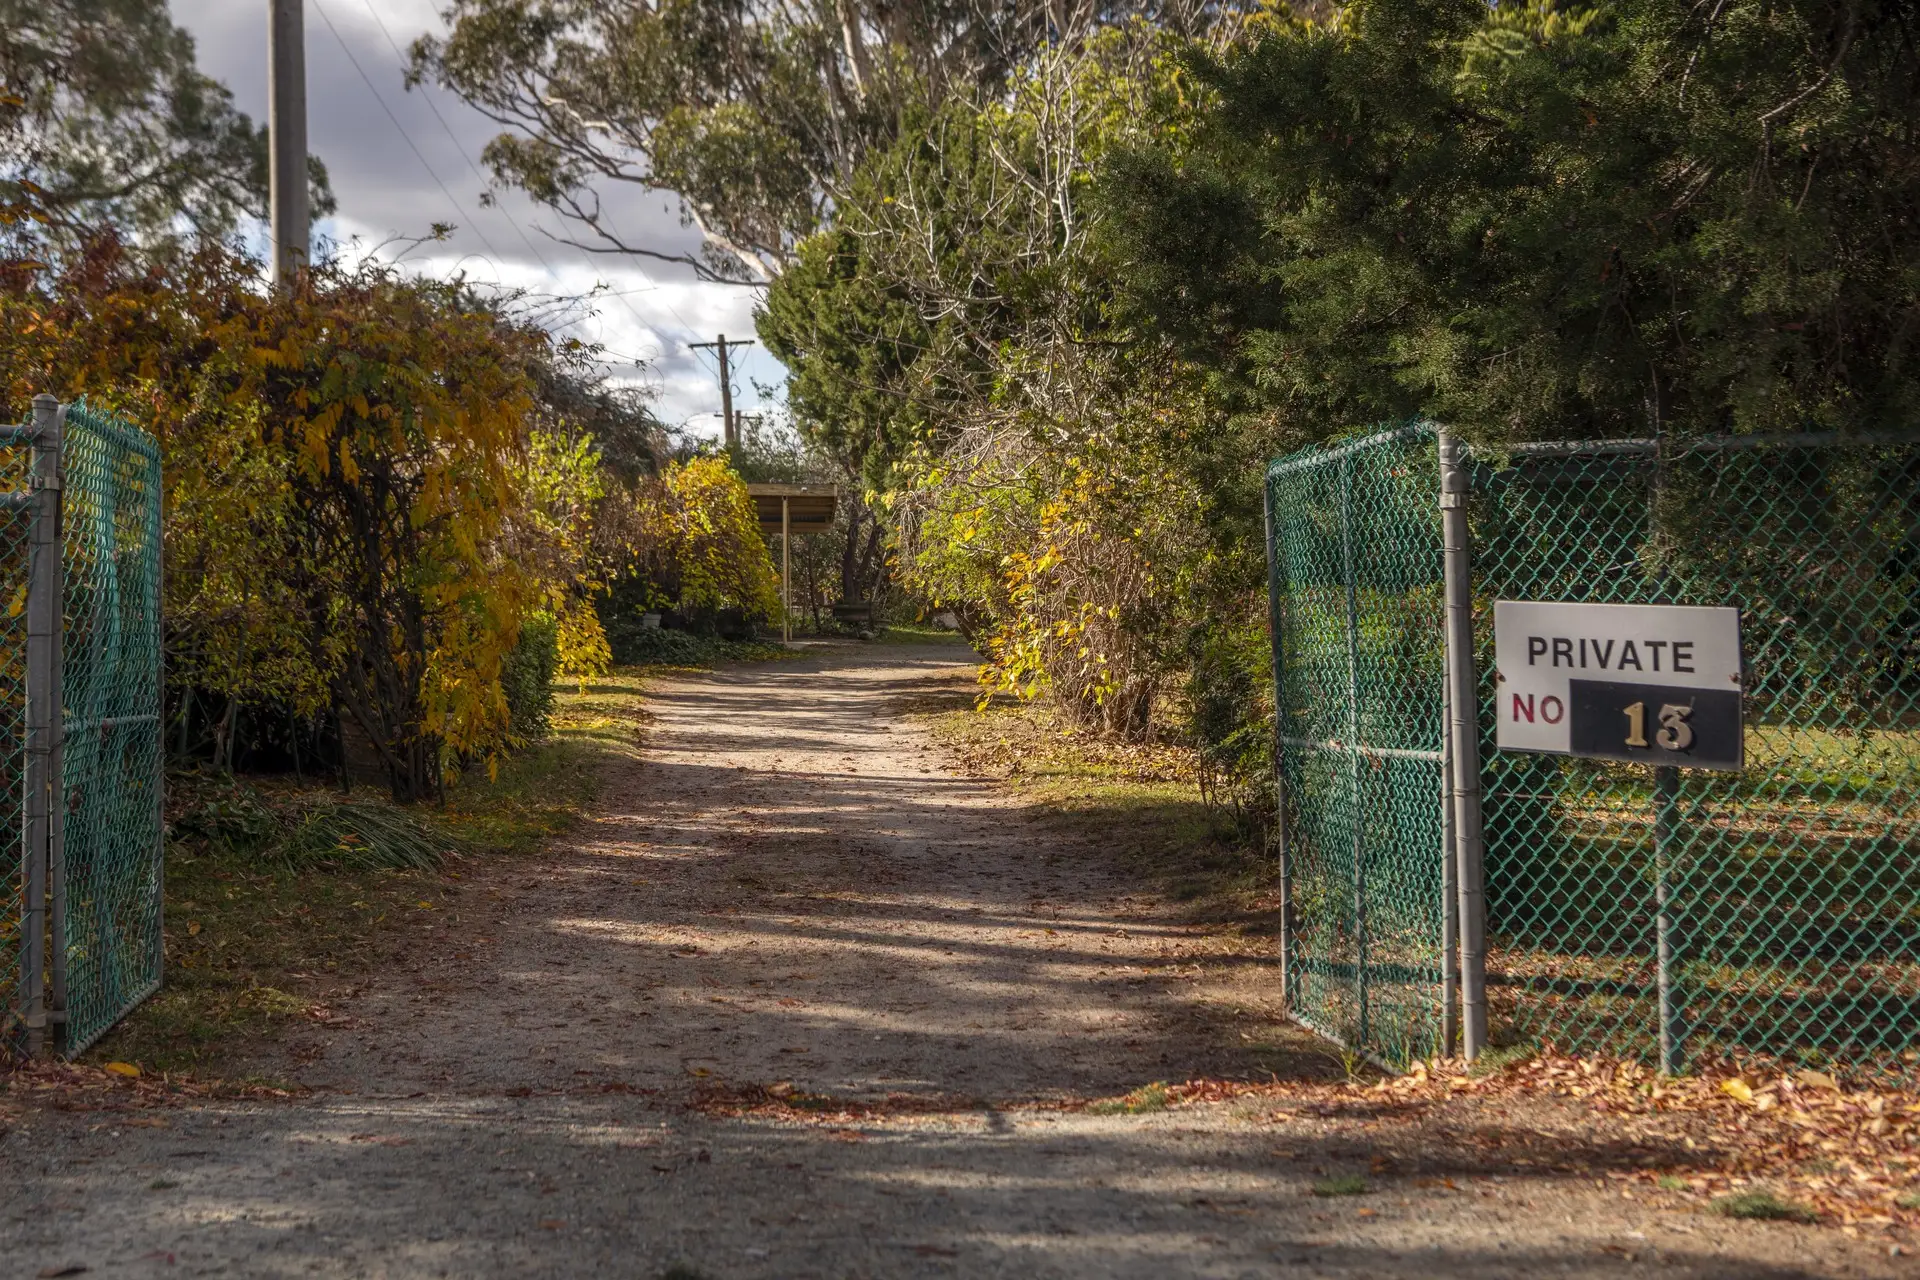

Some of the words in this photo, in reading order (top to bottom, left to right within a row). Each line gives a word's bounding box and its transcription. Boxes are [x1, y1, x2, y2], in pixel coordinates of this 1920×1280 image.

[1528, 636, 1695, 673] PRIVATE
[1512, 693, 1564, 724] NO
[1623, 701, 1693, 750] 13
